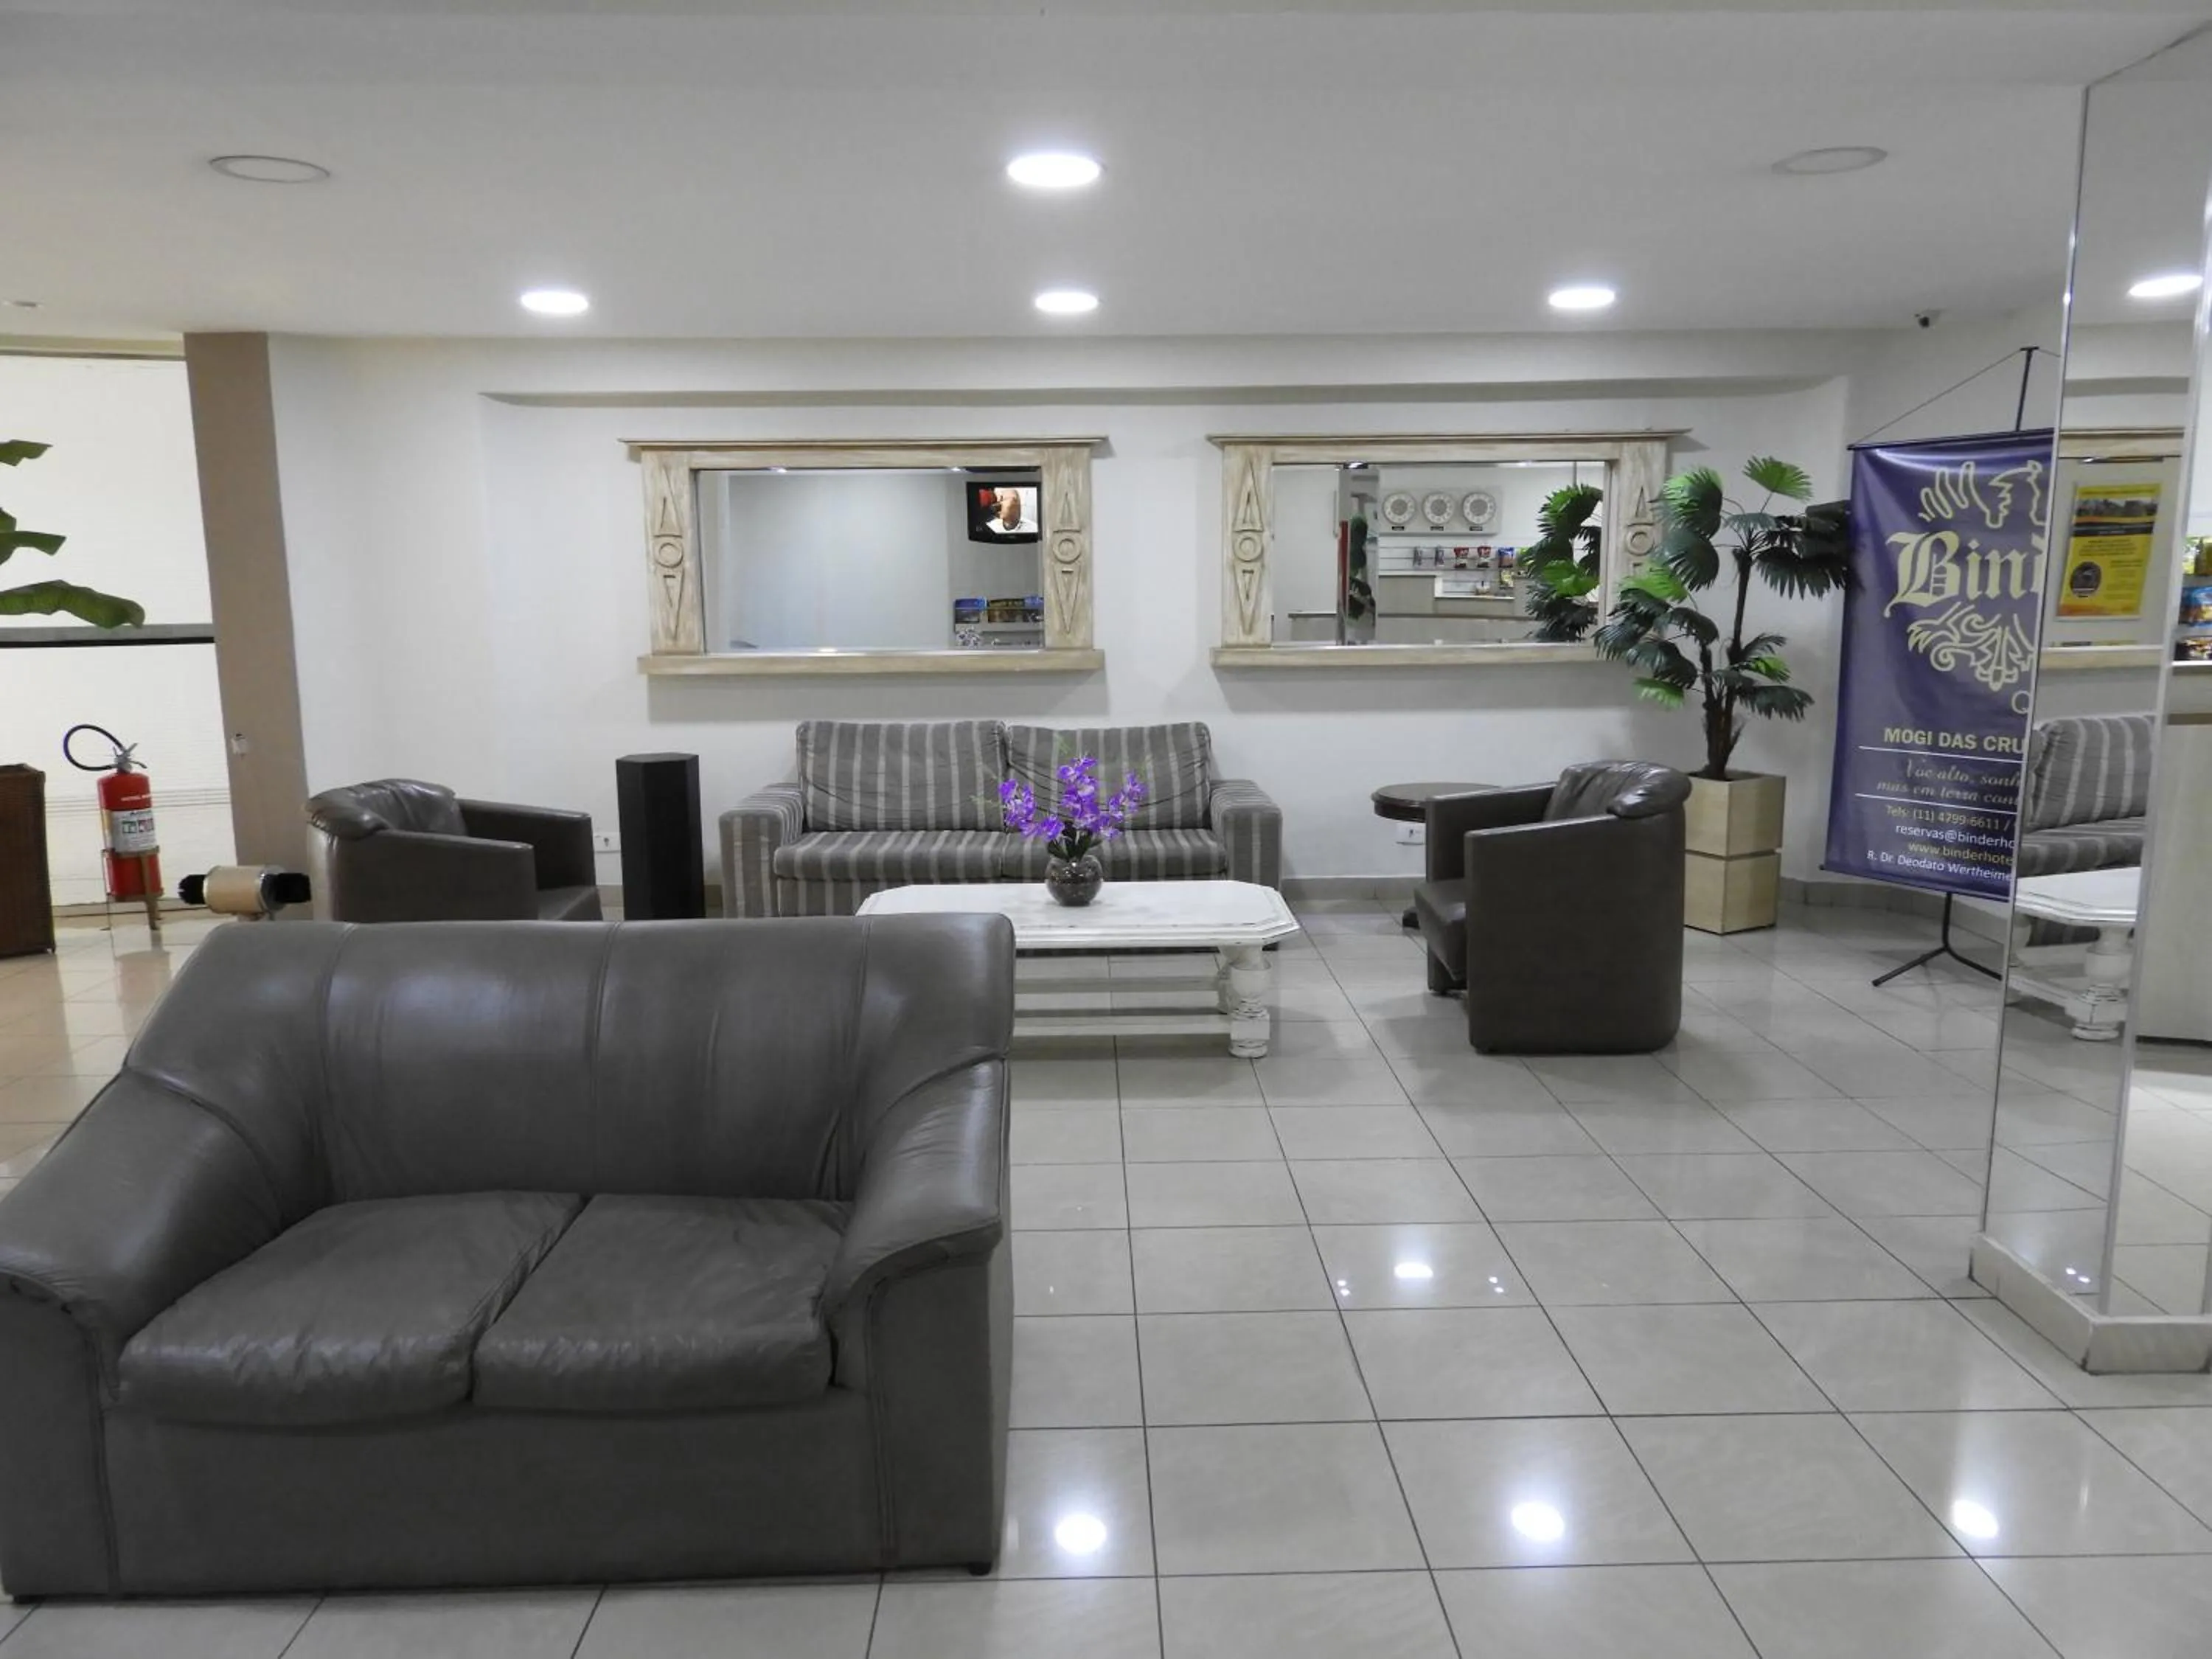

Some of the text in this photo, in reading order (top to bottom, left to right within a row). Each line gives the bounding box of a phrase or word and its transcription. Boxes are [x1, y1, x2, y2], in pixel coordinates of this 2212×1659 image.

[1884, 728, 2024, 754] MOGI DAS CRU
[1913, 808, 1934, 822] (11)
[1895, 824, 2015, 848] reservas@binderho
[1897, 855, 1944, 872] Deodato
